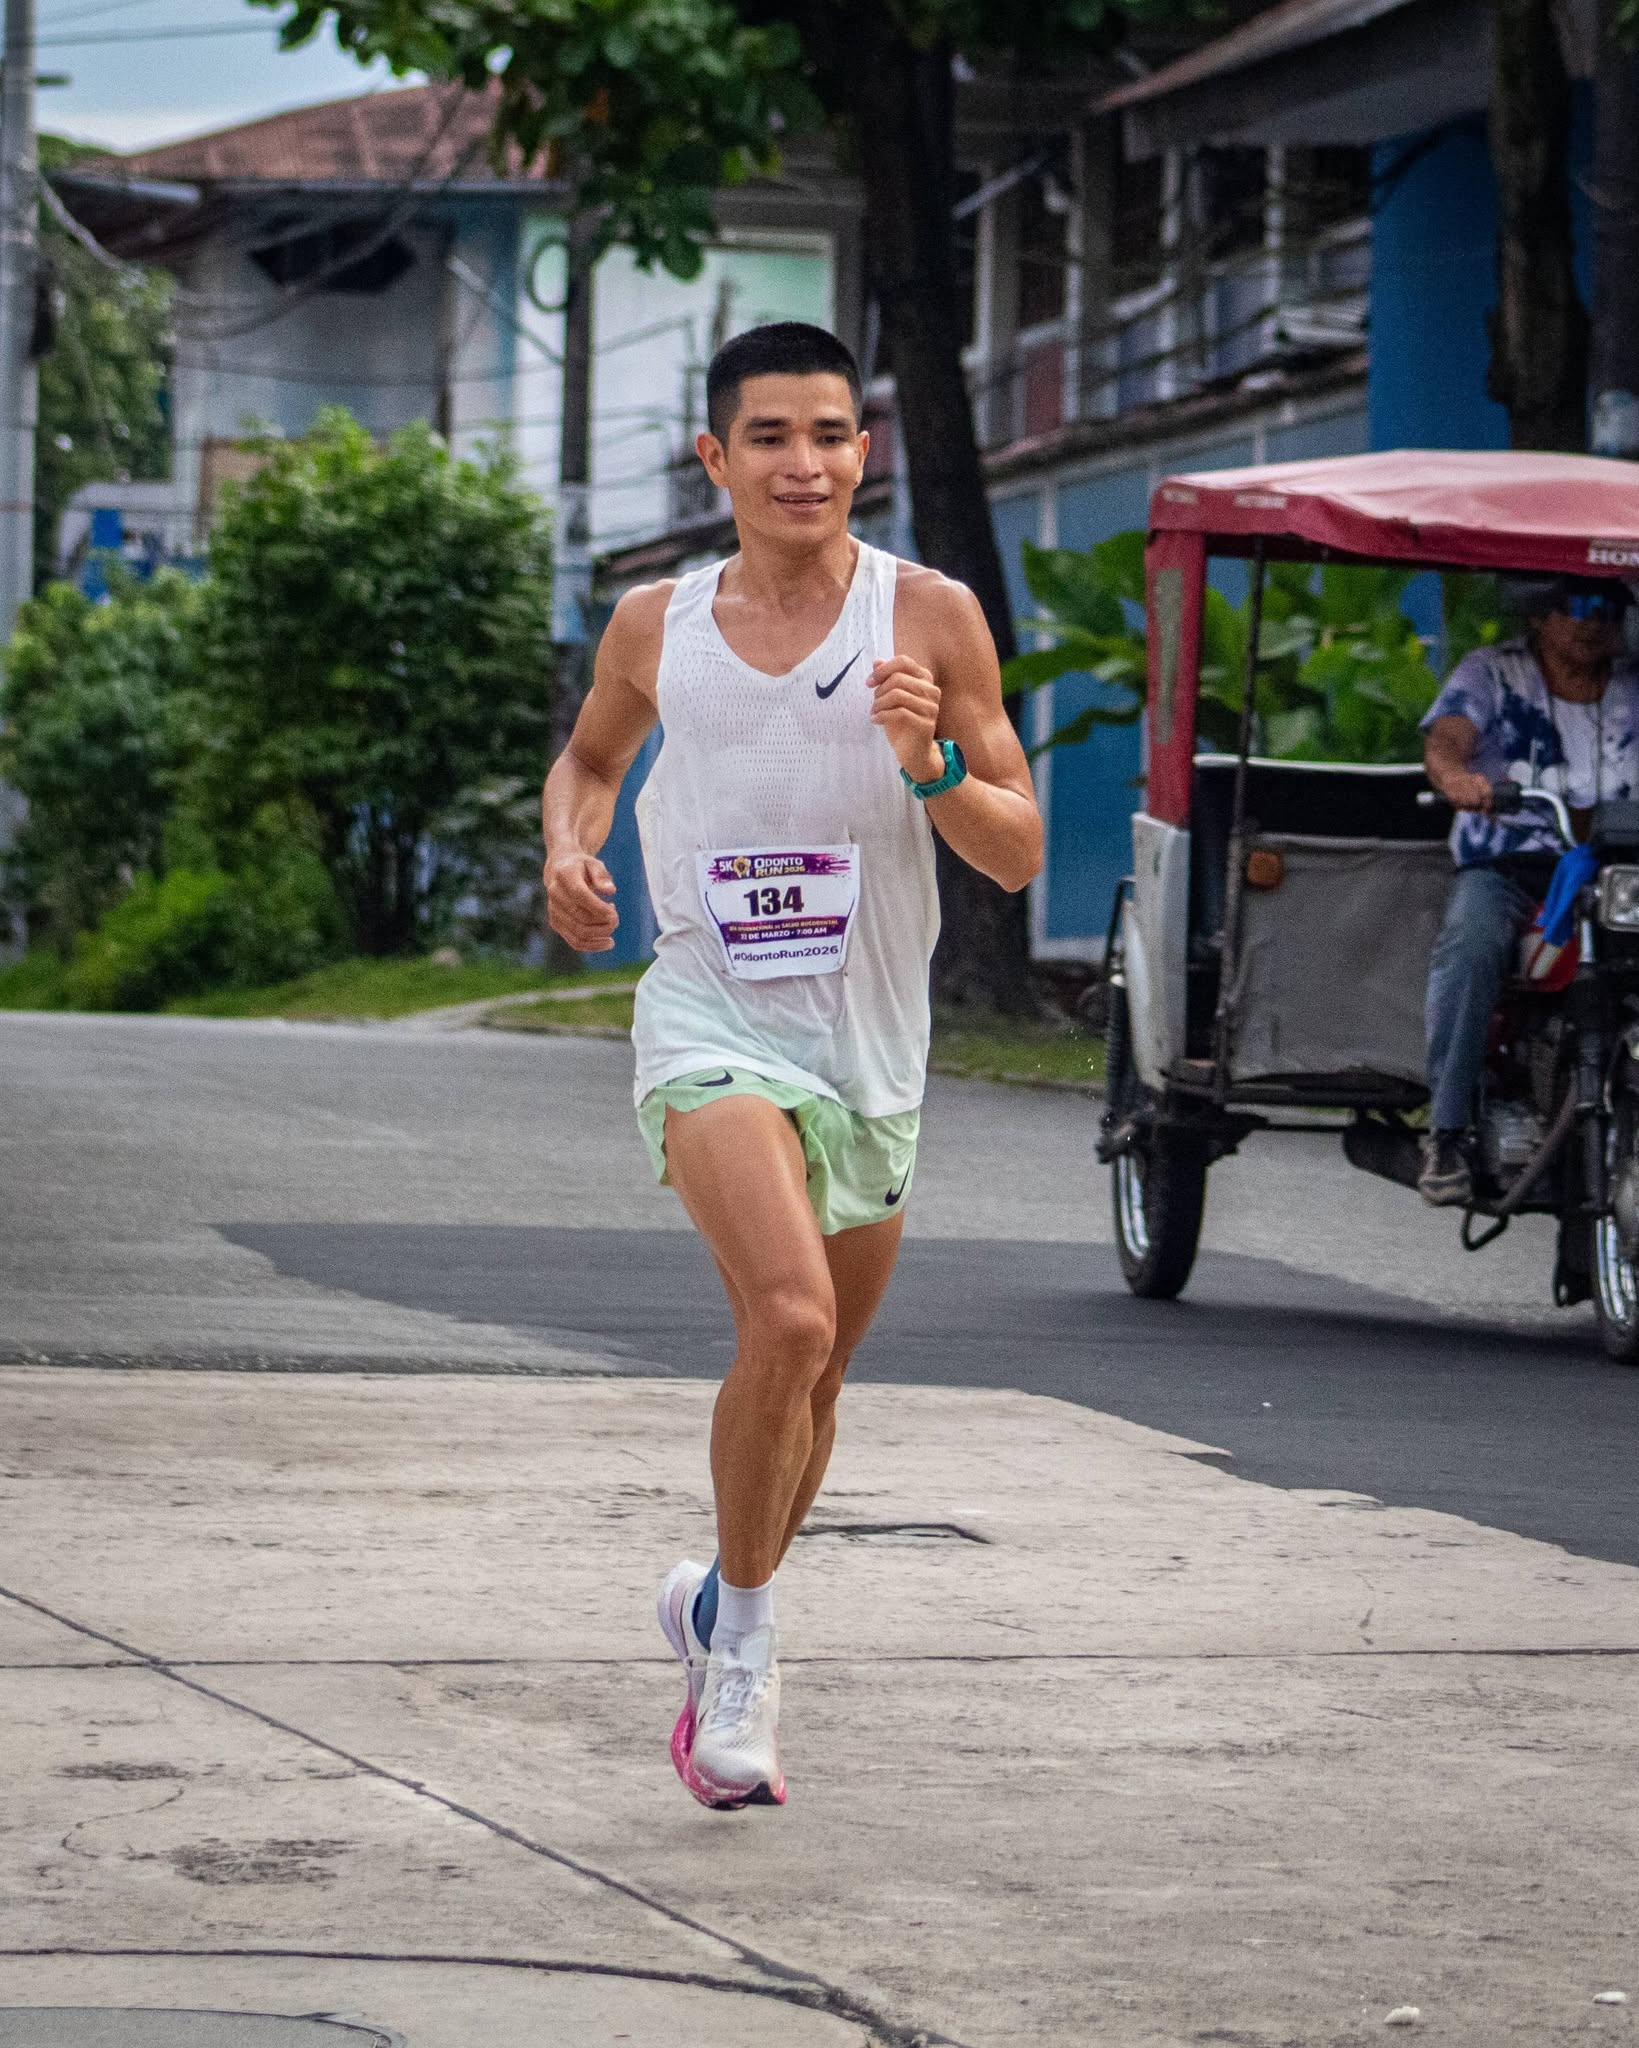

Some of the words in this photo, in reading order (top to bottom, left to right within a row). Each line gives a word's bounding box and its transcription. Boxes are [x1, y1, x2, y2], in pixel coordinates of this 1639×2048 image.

[719, 860, 734, 873] 5K
[754, 857, 804, 869] ODONTO
[755, 867, 783, 878] RUN
[743, 886, 804, 917] 134
[761, 930, 790, 939] MARZO
[734, 945, 839, 962] #OdontoRun2026
